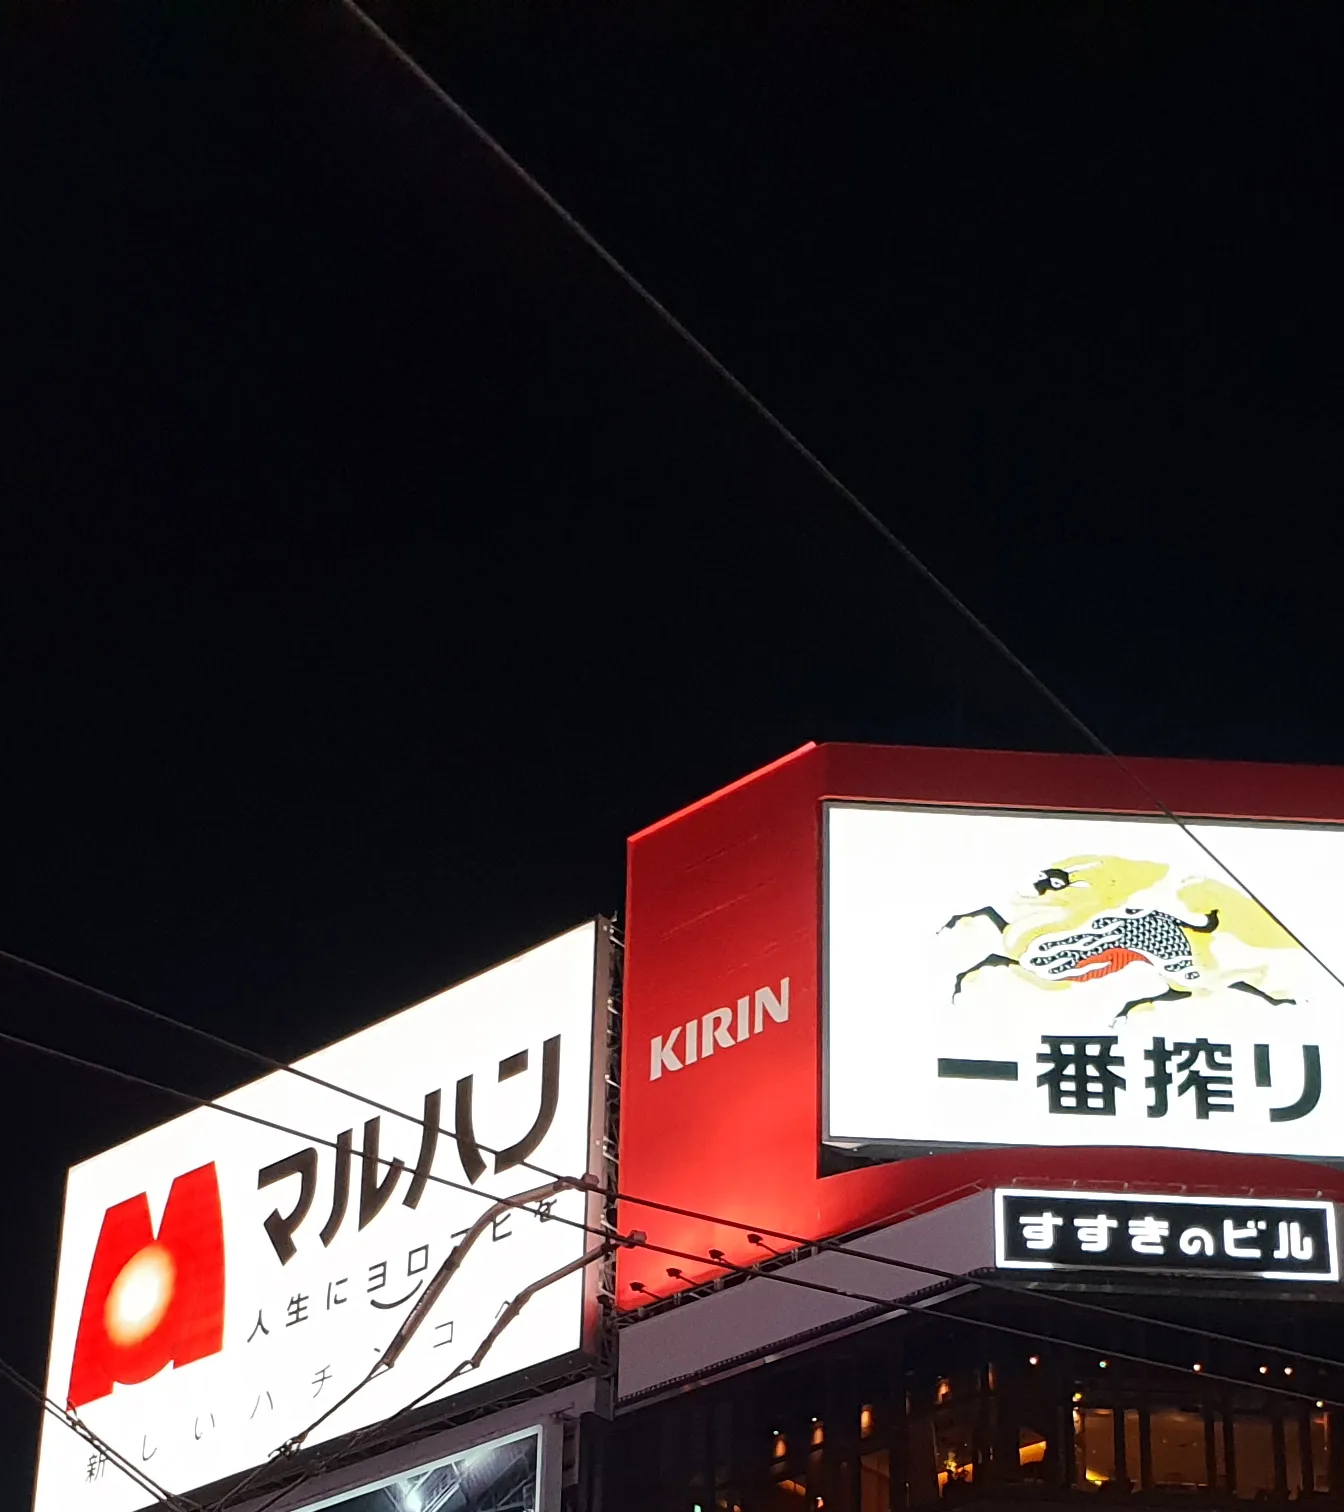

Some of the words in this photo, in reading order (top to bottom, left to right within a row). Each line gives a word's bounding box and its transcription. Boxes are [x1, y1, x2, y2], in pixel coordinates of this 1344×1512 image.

[648, 975, 792, 1082] KIRIN
[937, 1031, 1323, 1123] 一番搾り
[257, 1033, 562, 1267] マルハン
[1018, 1210, 1314, 1262] すすきのビル
